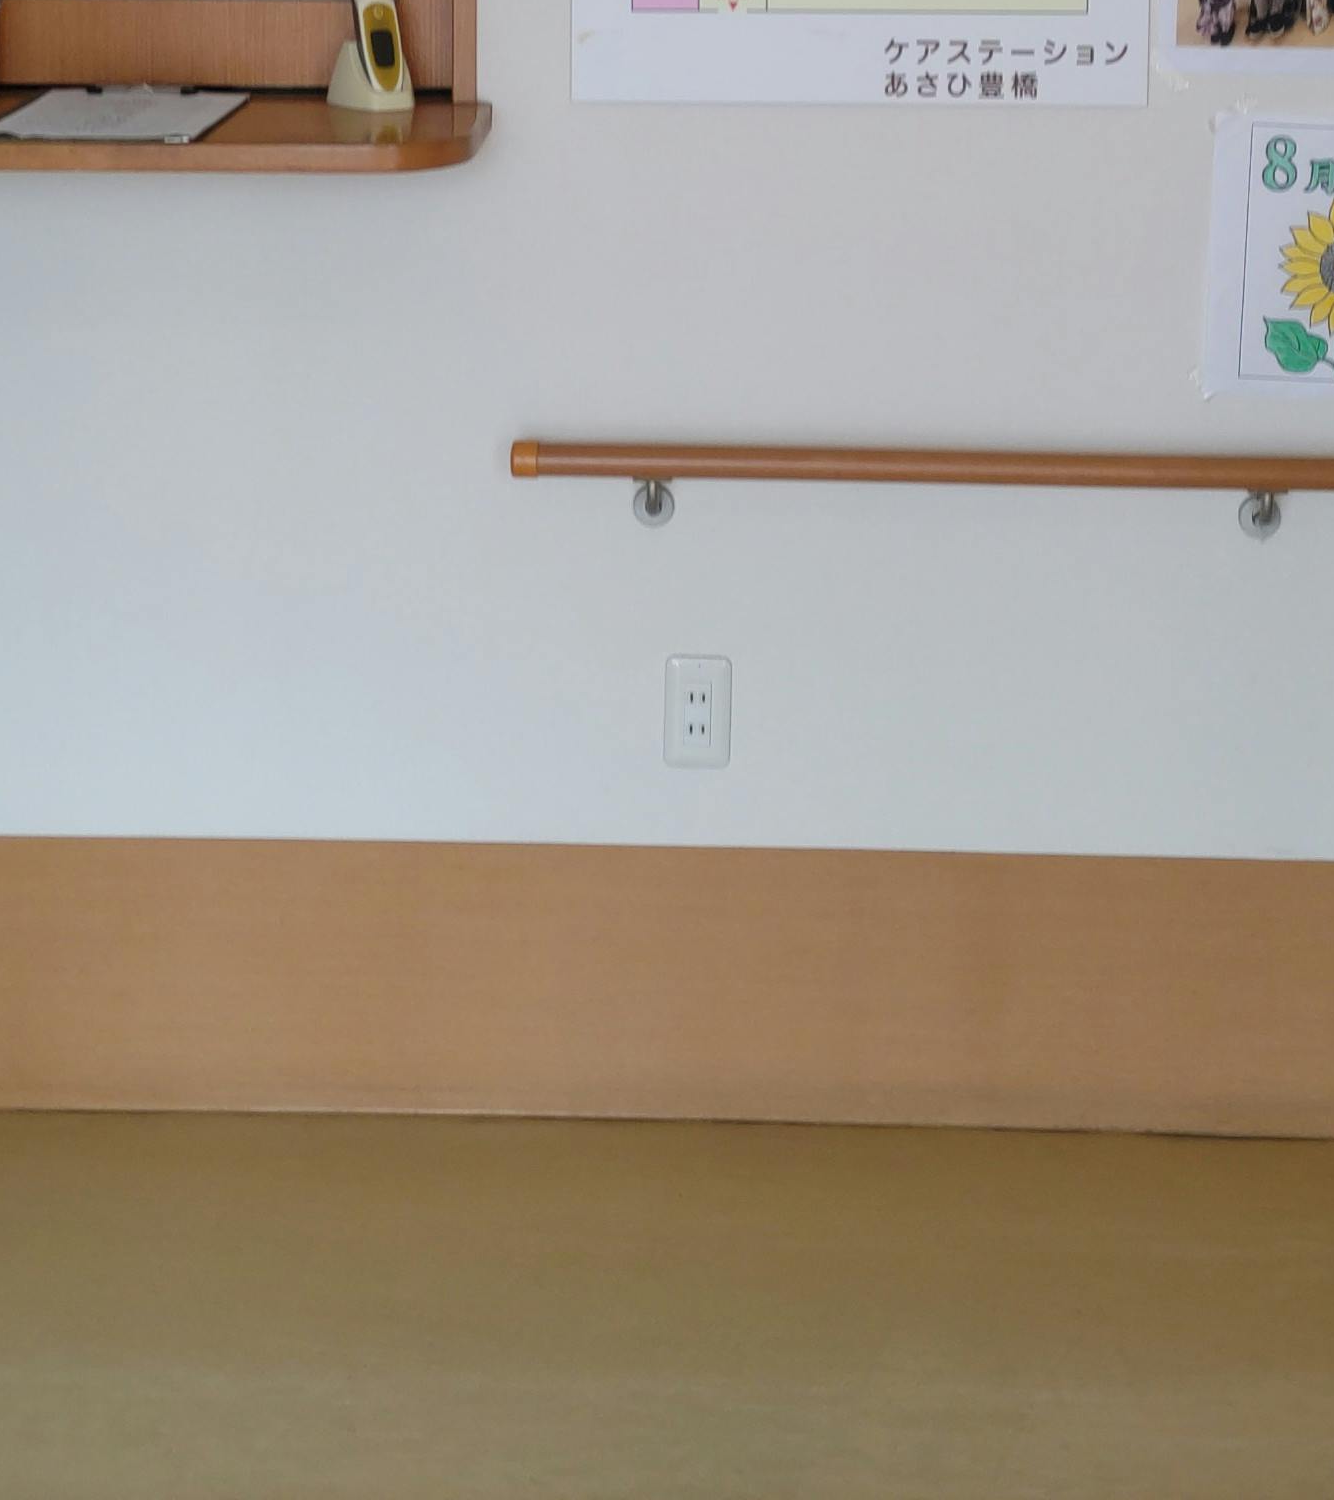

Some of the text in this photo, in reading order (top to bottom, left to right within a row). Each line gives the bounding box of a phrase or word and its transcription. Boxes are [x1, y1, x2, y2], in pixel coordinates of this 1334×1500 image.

[884, 36, 1130, 67] ケアステーション
[884, 70, 1039, 100] あさひ豊橋
